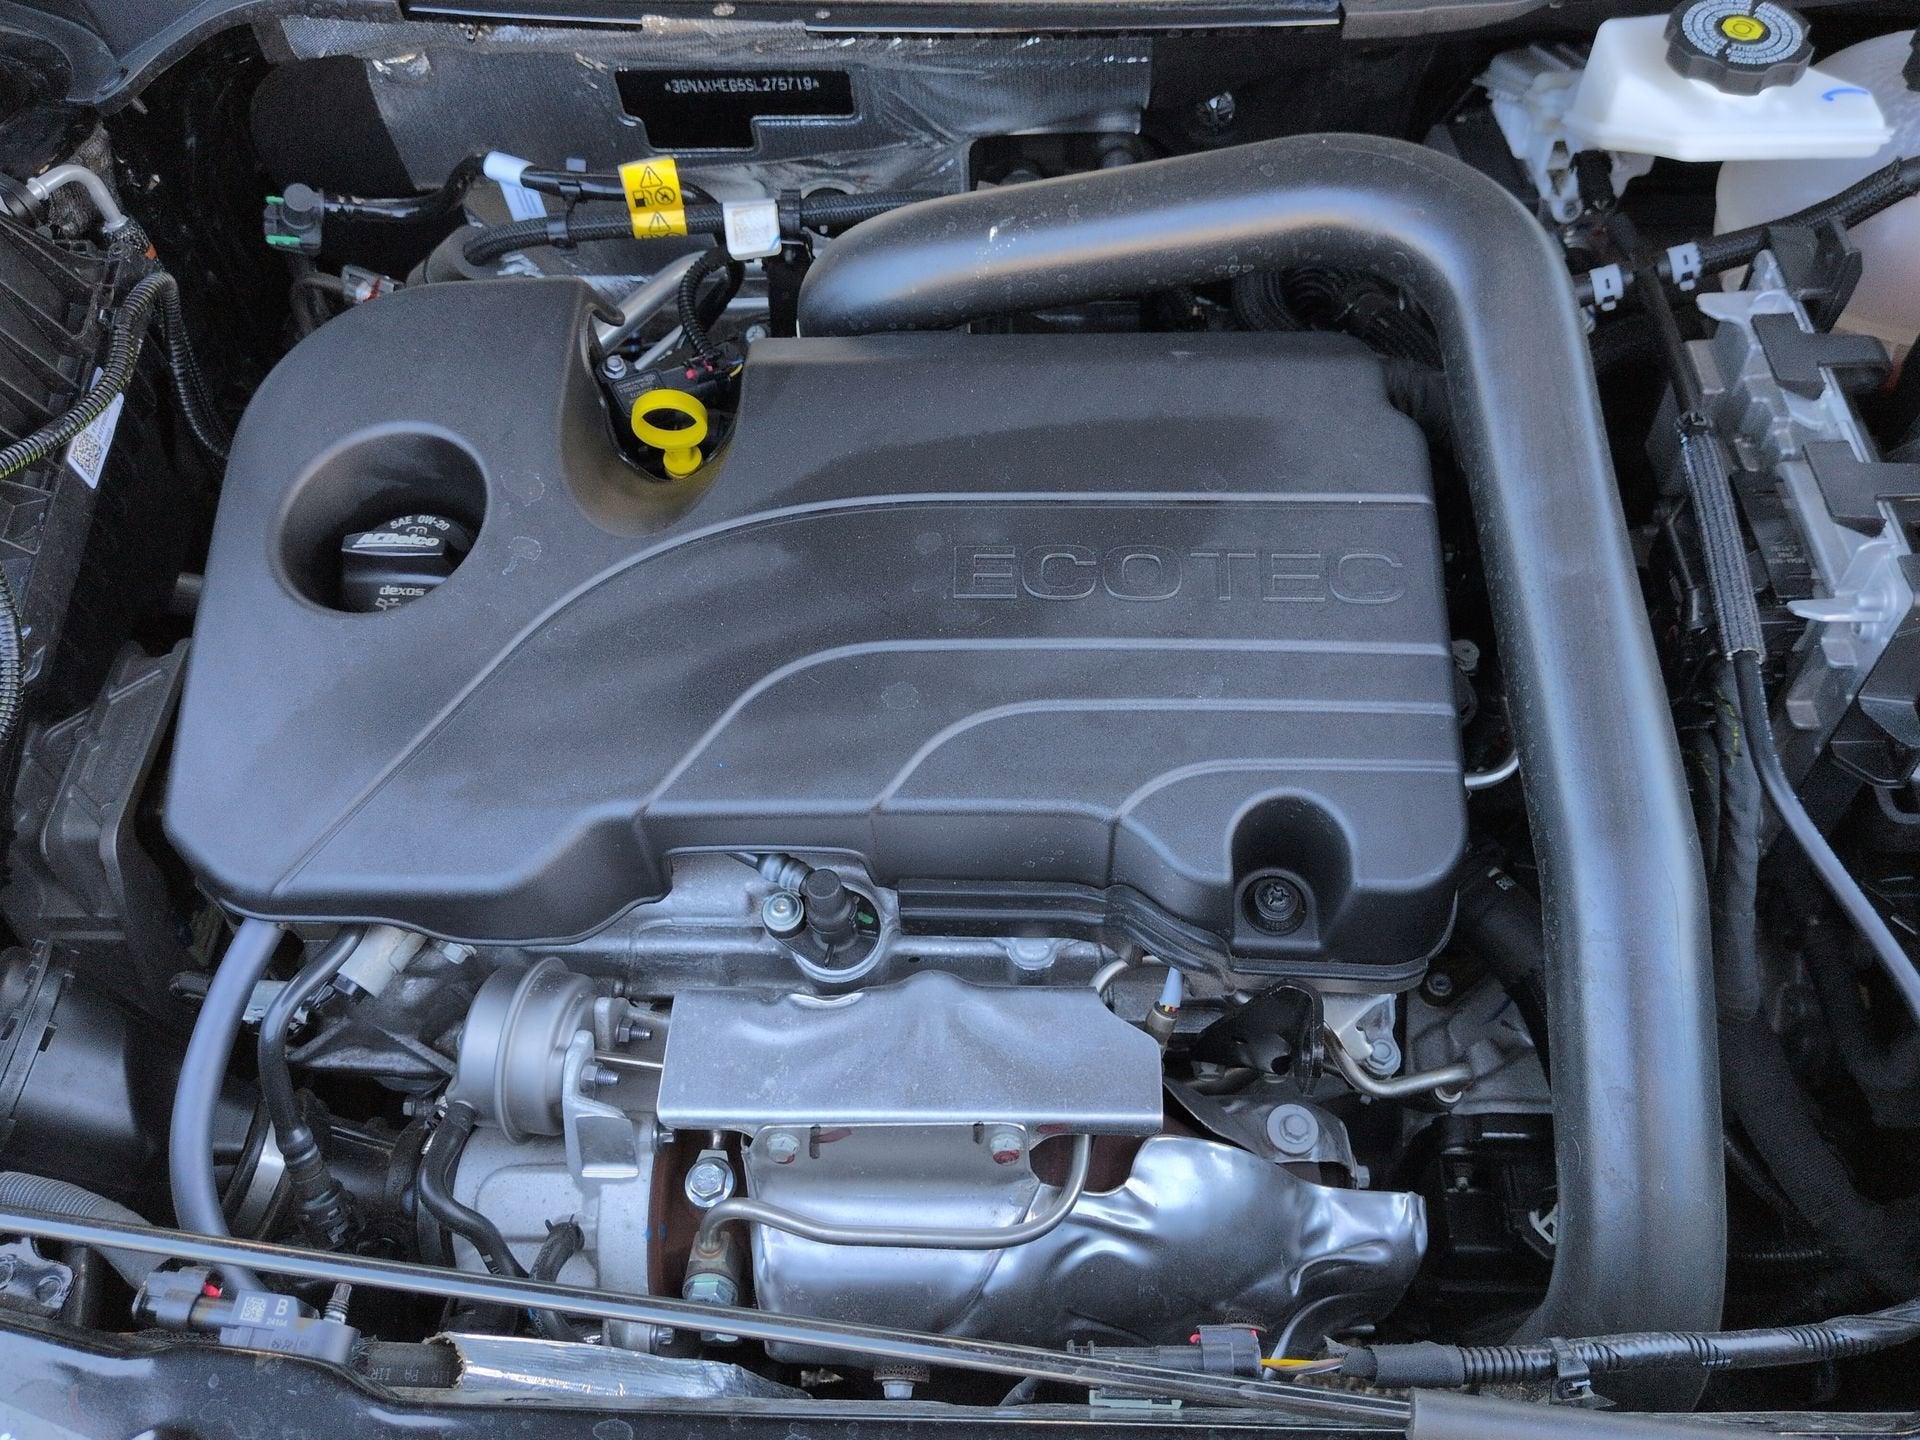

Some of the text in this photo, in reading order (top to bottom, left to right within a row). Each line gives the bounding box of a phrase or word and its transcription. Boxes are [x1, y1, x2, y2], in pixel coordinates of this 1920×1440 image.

[390, 514, 450, 530] SAE 0W-20
[356, 533, 440, 546] ACDelco
[953, 544, 1405, 604] ECOTEC
[379, 585, 426, 596] dexos
[275, 1298, 288, 1316] B
